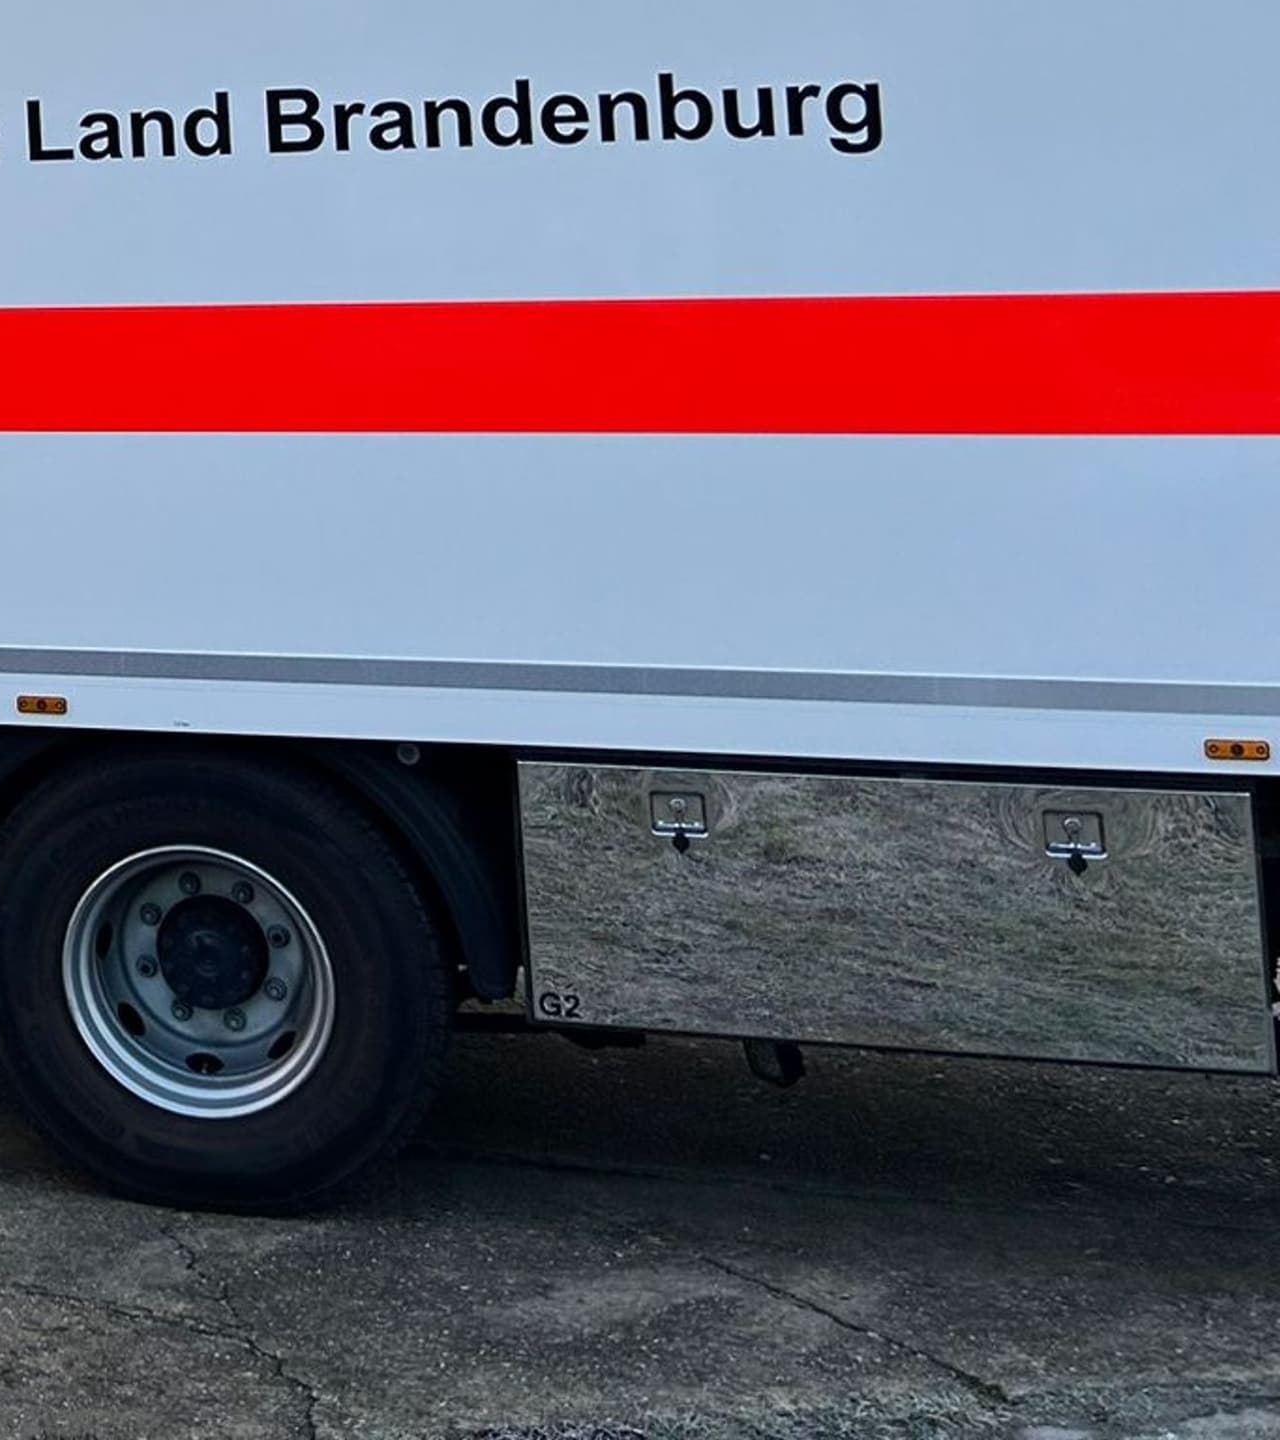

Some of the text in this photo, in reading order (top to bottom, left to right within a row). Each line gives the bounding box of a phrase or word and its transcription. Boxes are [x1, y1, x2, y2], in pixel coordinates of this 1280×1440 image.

[25, 90, 233, 162] Land
[264, 72, 883, 155] Brandenburg
[539, 992, 584, 1019] G2
